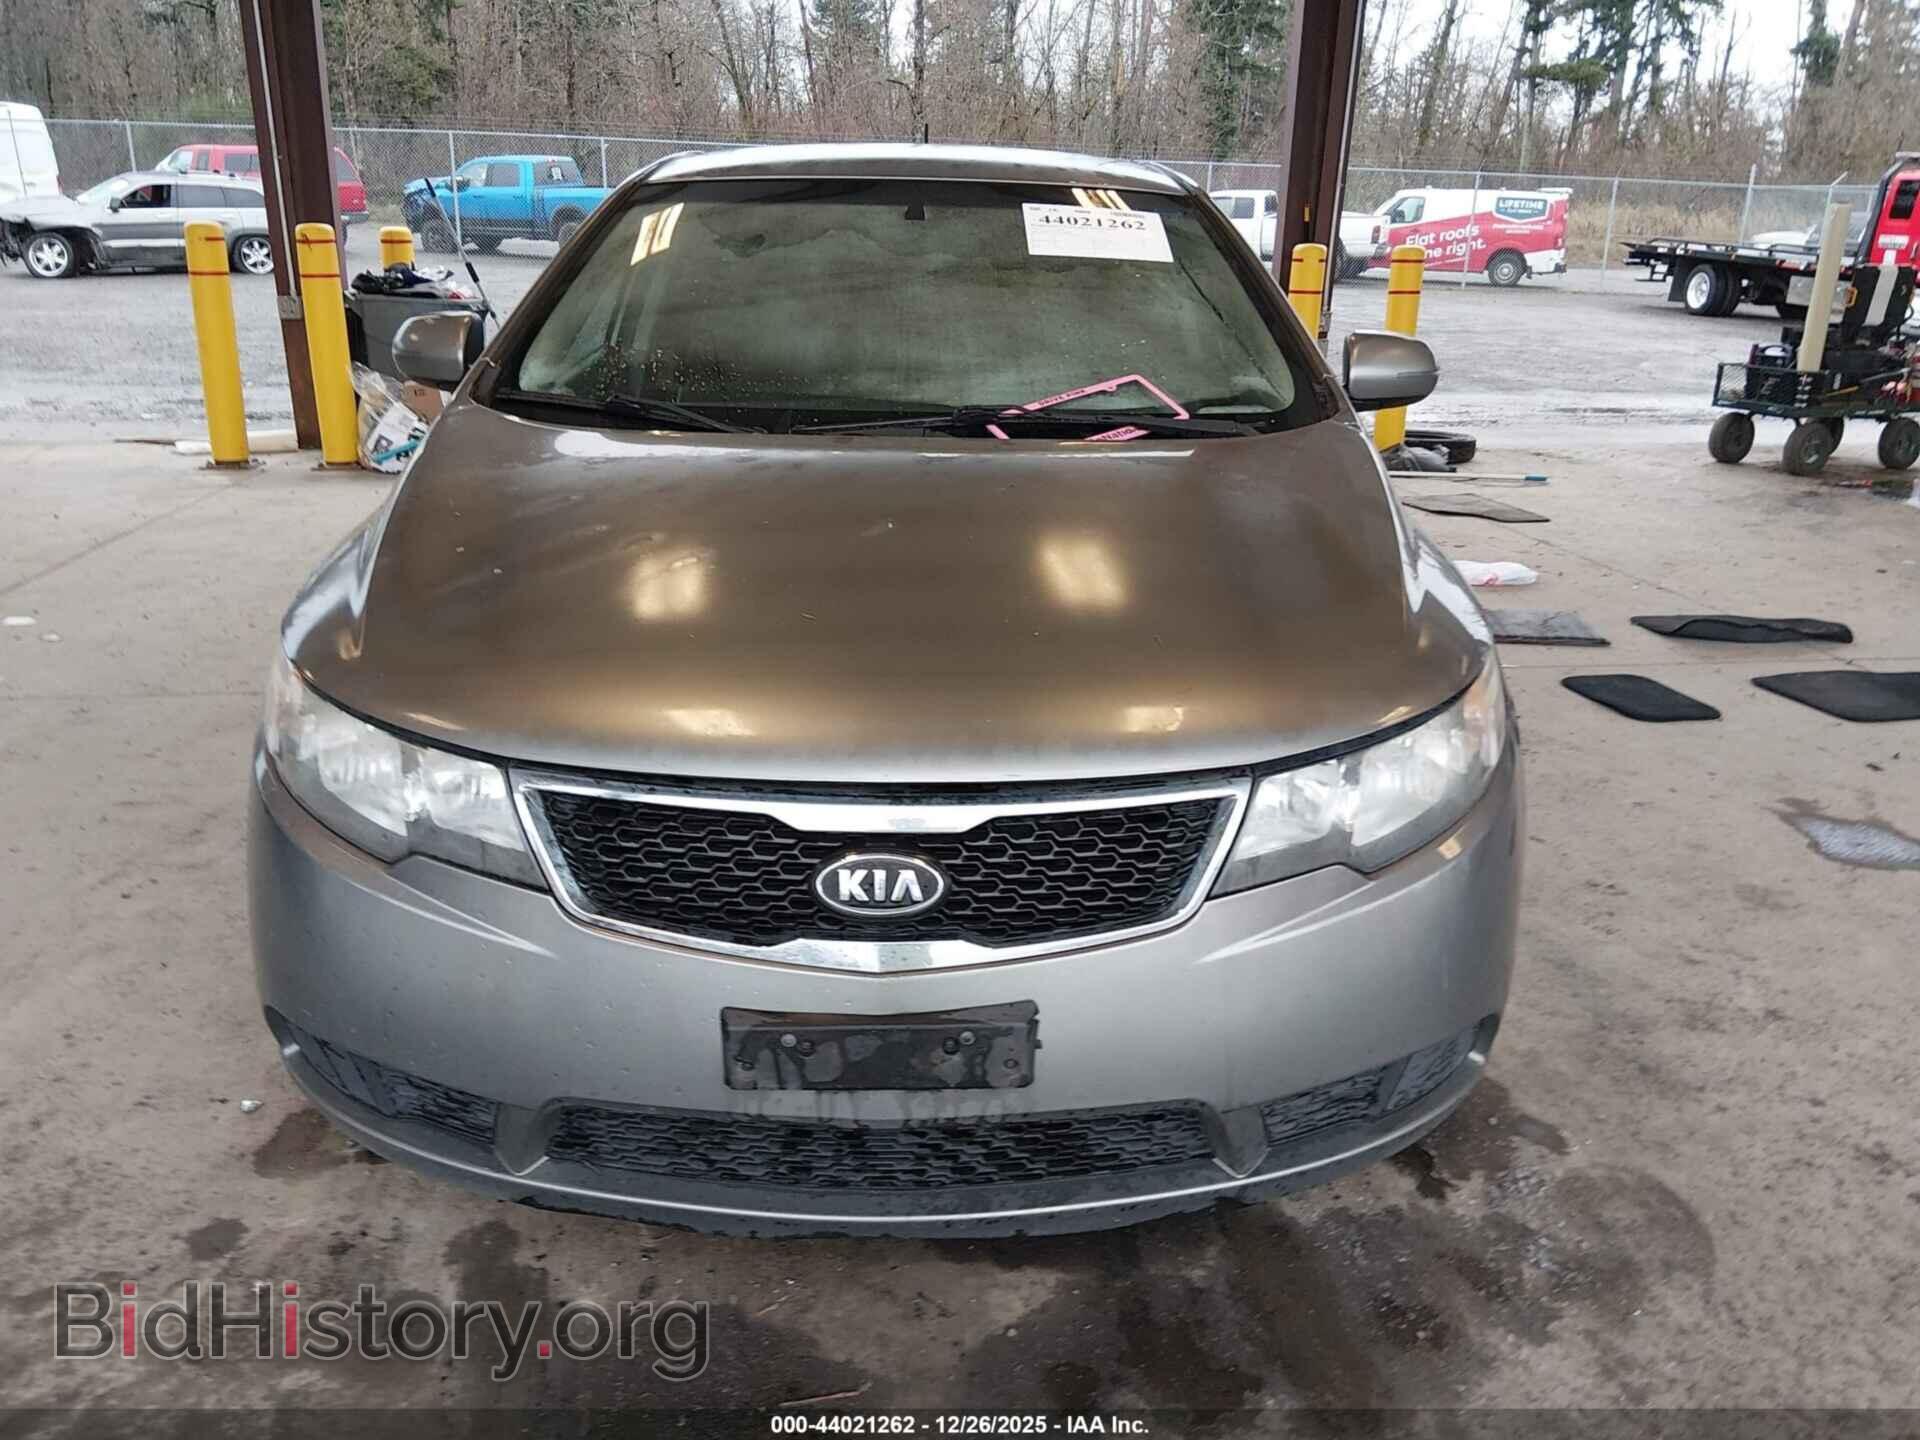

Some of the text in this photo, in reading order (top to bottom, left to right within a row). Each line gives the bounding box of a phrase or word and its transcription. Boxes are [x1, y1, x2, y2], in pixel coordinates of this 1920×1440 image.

[1040, 215, 1146, 230] 44021262
[1405, 232, 1436, 247] Flat
[1439, 223, 1480, 242] roofs
[1424, 247, 1442, 260] ne
[837, 868, 924, 901] KIA
